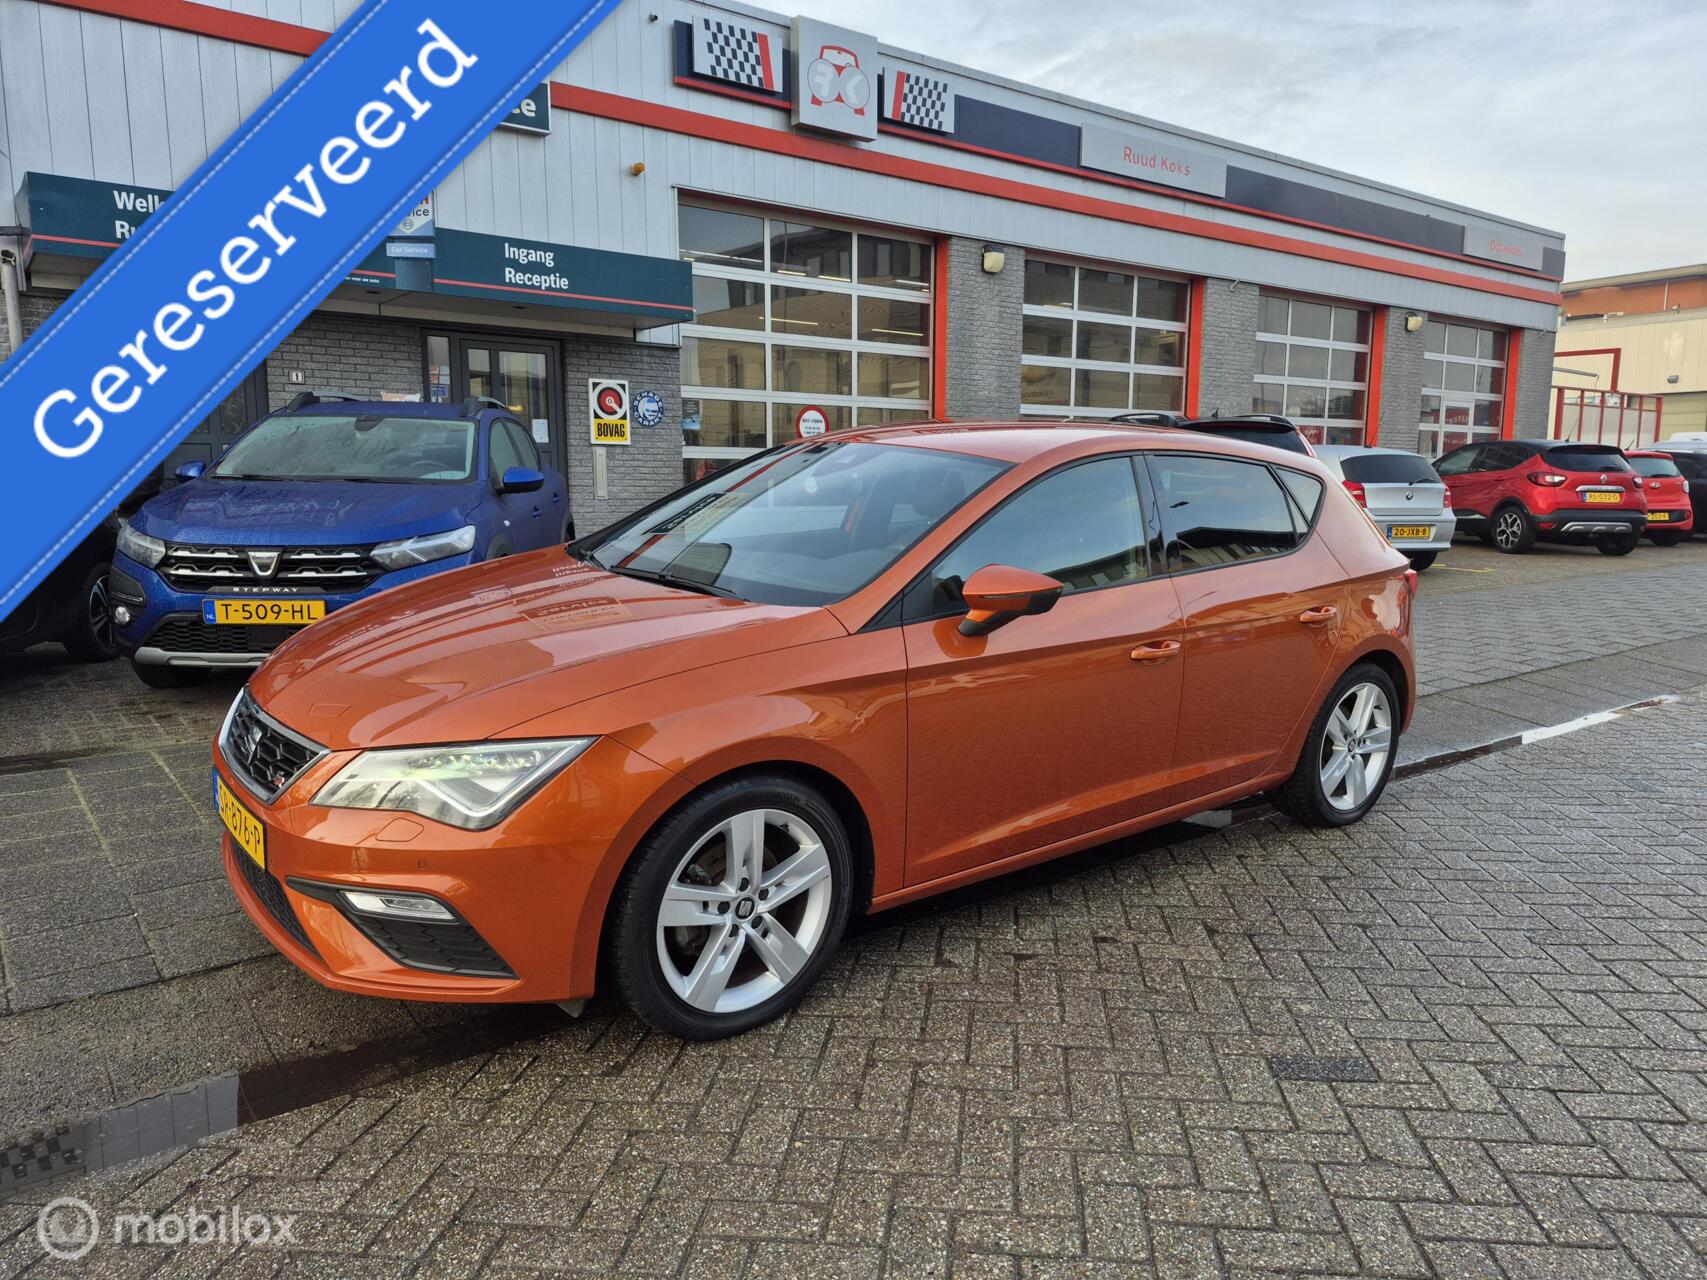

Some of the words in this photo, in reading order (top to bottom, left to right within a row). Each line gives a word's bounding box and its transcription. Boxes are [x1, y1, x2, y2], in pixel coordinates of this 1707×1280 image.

[1123, 146, 1157, 168] Ruud
[1161, 156, 1191, 176] Koks
[404, 246, 429, 255] Service
[504, 242, 555, 268] Ingang
[504, 267, 569, 290] Receptie
[597, 422, 626, 438] BOVAG
[1395, 527, 1427, 536] 20-JXB-8
[220, 603, 318, 620] T-509-HL
[219, 783, 261, 854] SR-876-P
